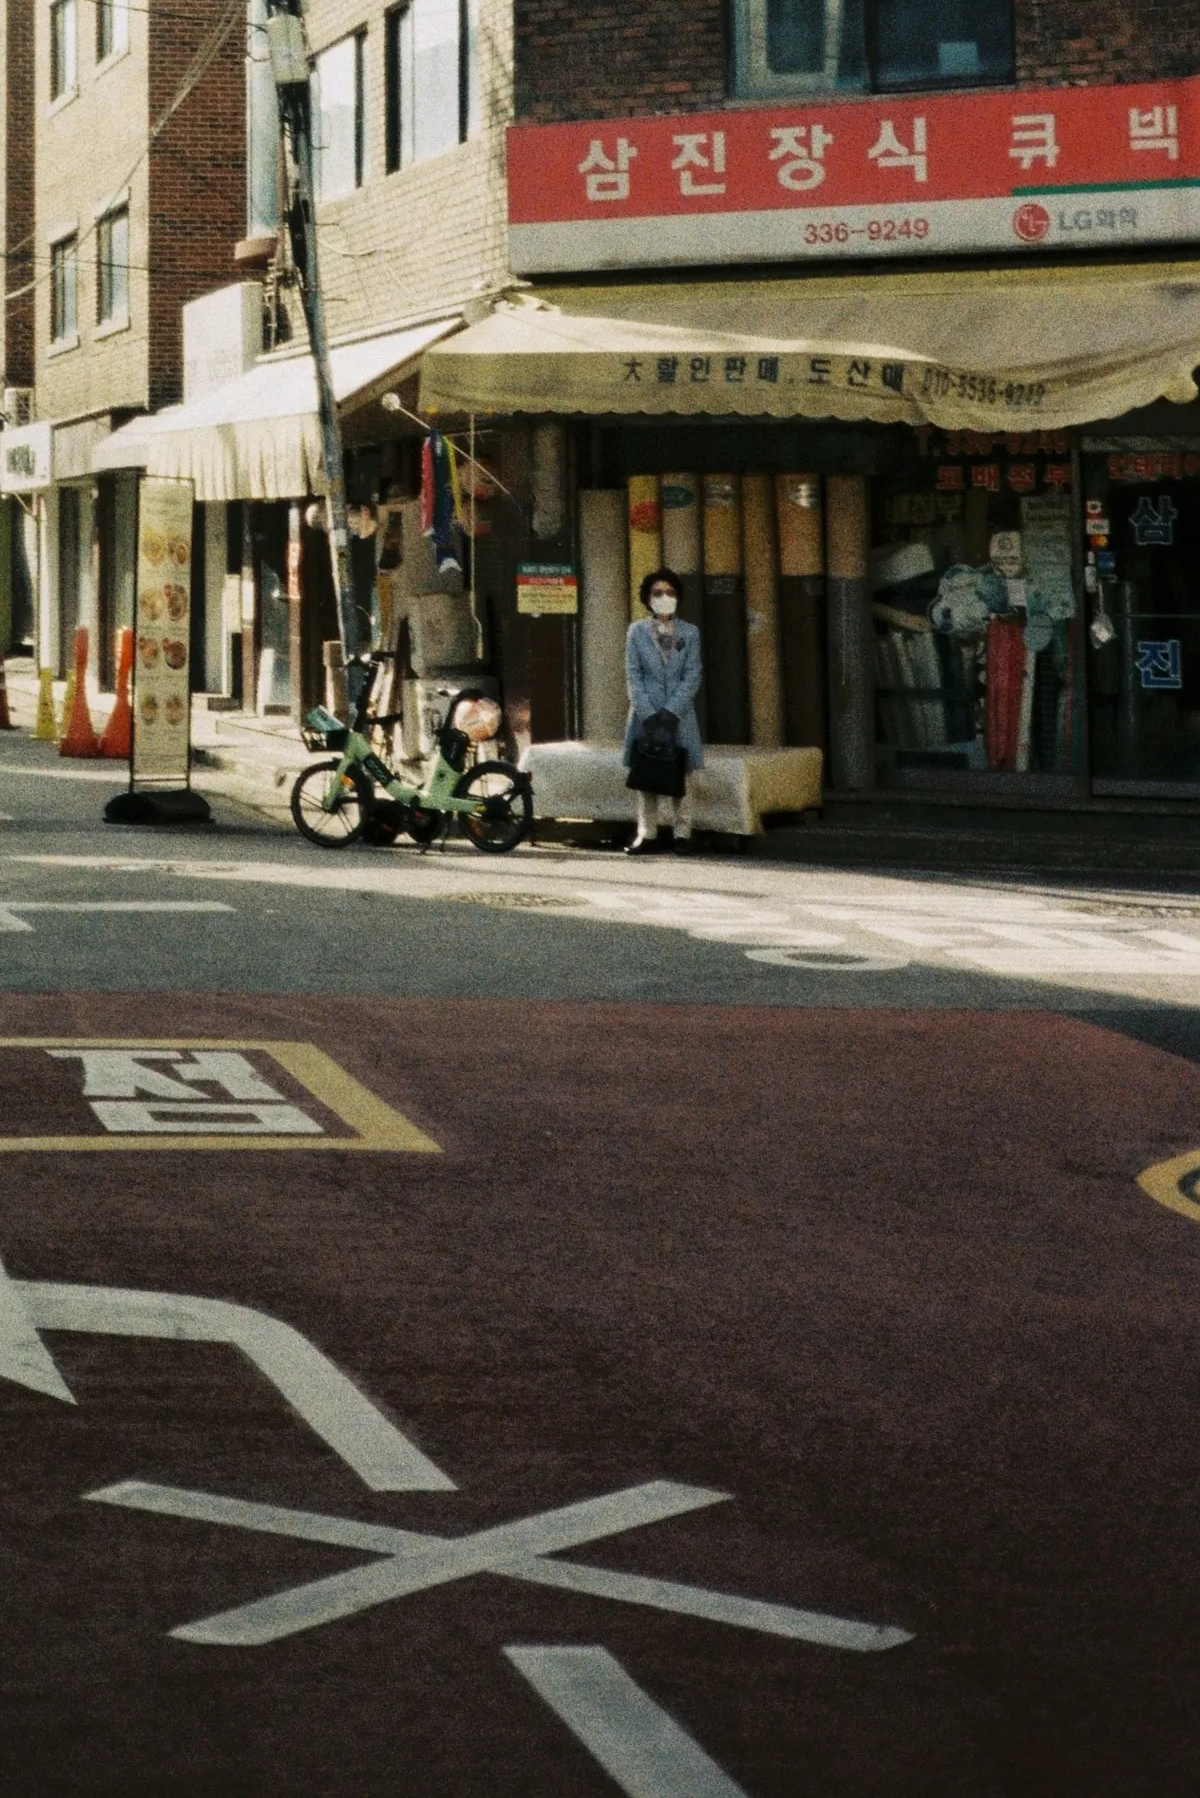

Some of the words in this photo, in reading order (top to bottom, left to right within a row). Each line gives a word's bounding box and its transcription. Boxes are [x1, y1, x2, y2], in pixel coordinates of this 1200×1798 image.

[577, 116, 929, 203] 삼진장식
[1007, 105, 1179, 171] 큐빅
[803, 217, 930, 244] 336-9249
